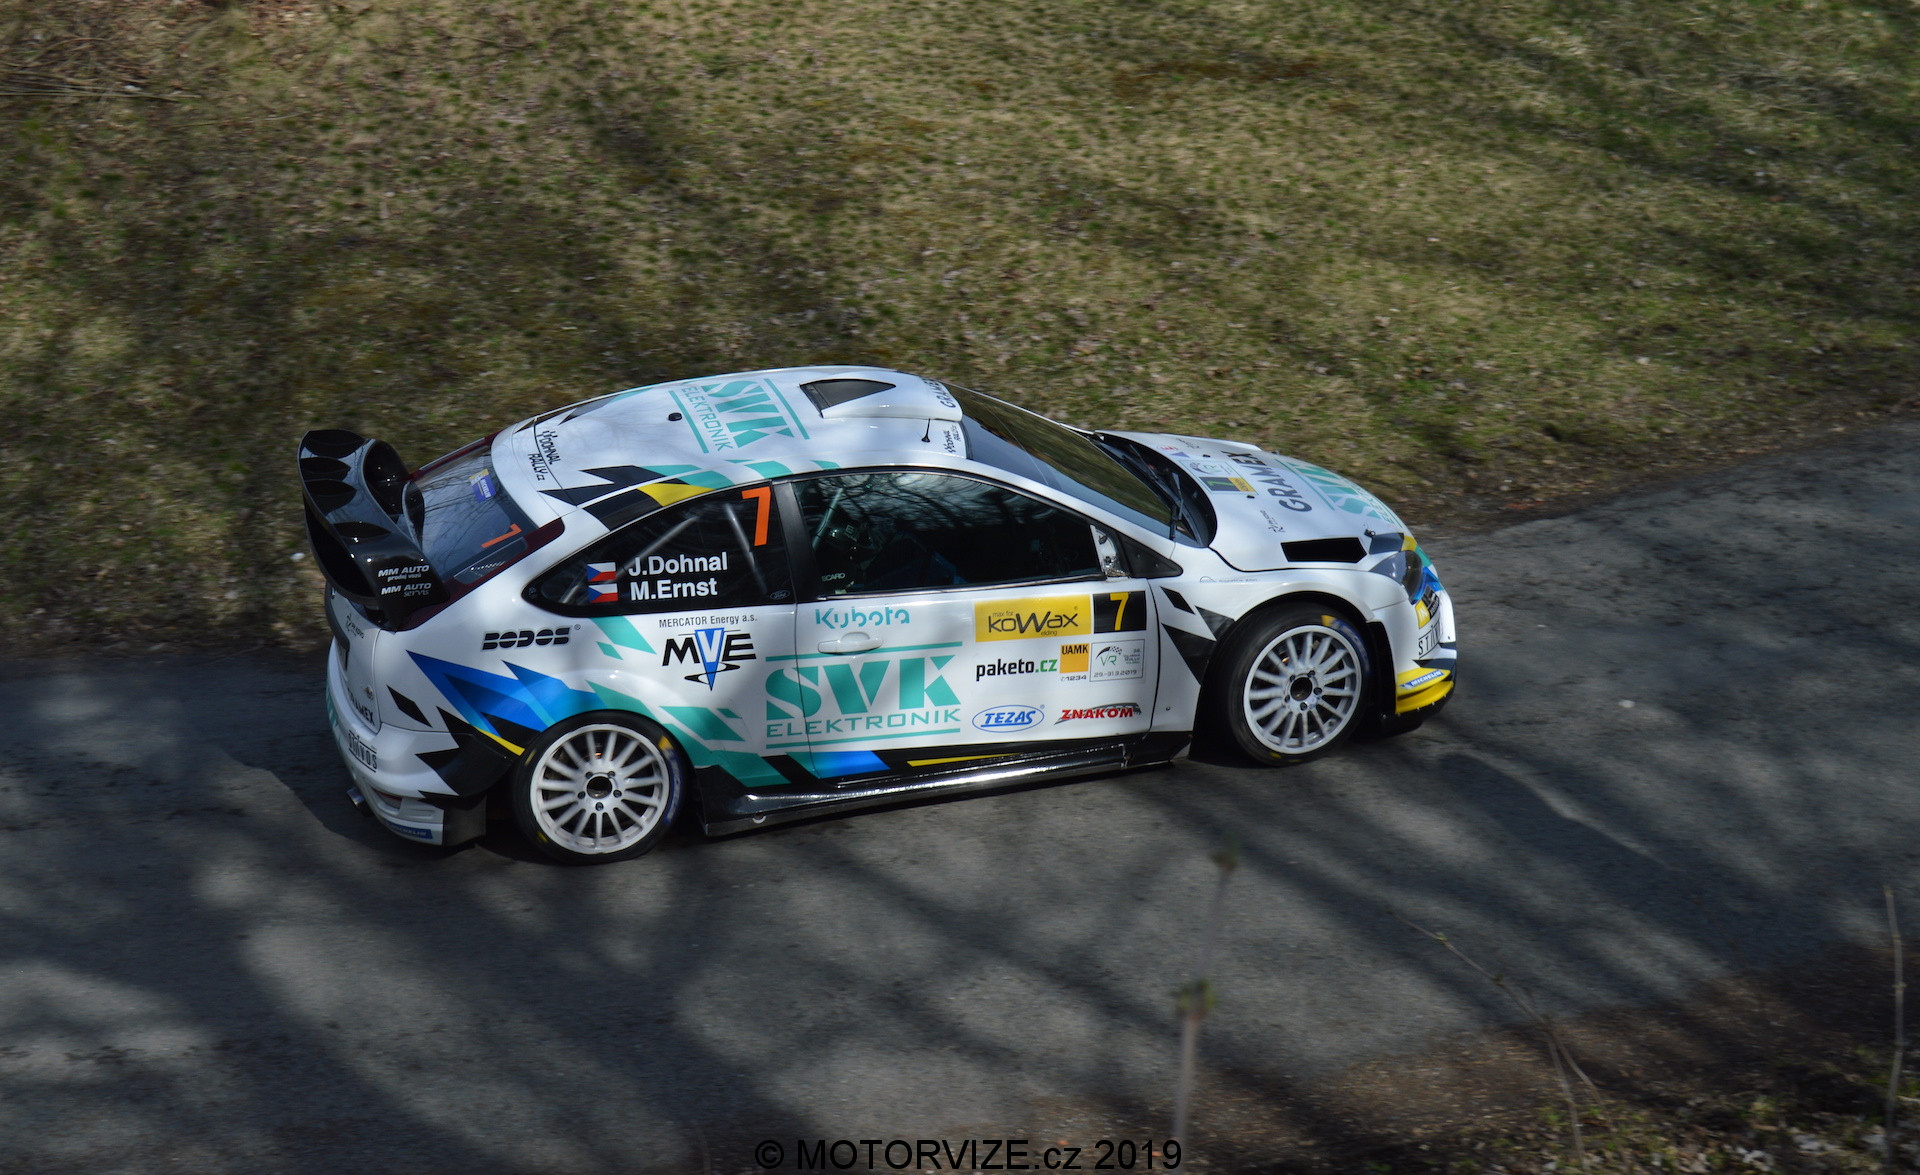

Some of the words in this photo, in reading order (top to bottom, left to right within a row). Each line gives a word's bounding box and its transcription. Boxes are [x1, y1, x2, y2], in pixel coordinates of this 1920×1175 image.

[681, 385, 734, 452] ELEKTRONIK
[701, 380, 795, 448] SVK
[1221, 450, 1312, 512] GRAMEX
[741, 486, 772, 547] 7
[377, 568, 400, 577] MM
[401, 564, 430, 574] AUTO
[628, 551, 728, 577] J.Dohnal
[380, 585, 402, 595] MM
[403, 582, 432, 591] AUTO
[630, 577, 718, 601] M.Ernst
[659, 616, 708, 628] MERCATOR
[709, 614, 740, 627] Energy
[742, 613, 758, 623] a.s.
[815, 606, 910, 630] Kubota
[1108, 592, 1131, 631] 7
[482, 627, 571, 650] BODOS
[1061, 644, 1089, 655] UAMK
[662, 628, 757, 674] MVE
[976, 658, 1057, 682] paketo.cz
[1411, 669, 1443, 687] MICHELIN
[766, 653, 961, 721] SVK
[766, 708, 961, 738] ELEKTRONIK
[983, 710, 1037, 725] TEZAS
[1061, 708, 1134, 720] ZNAKOM
